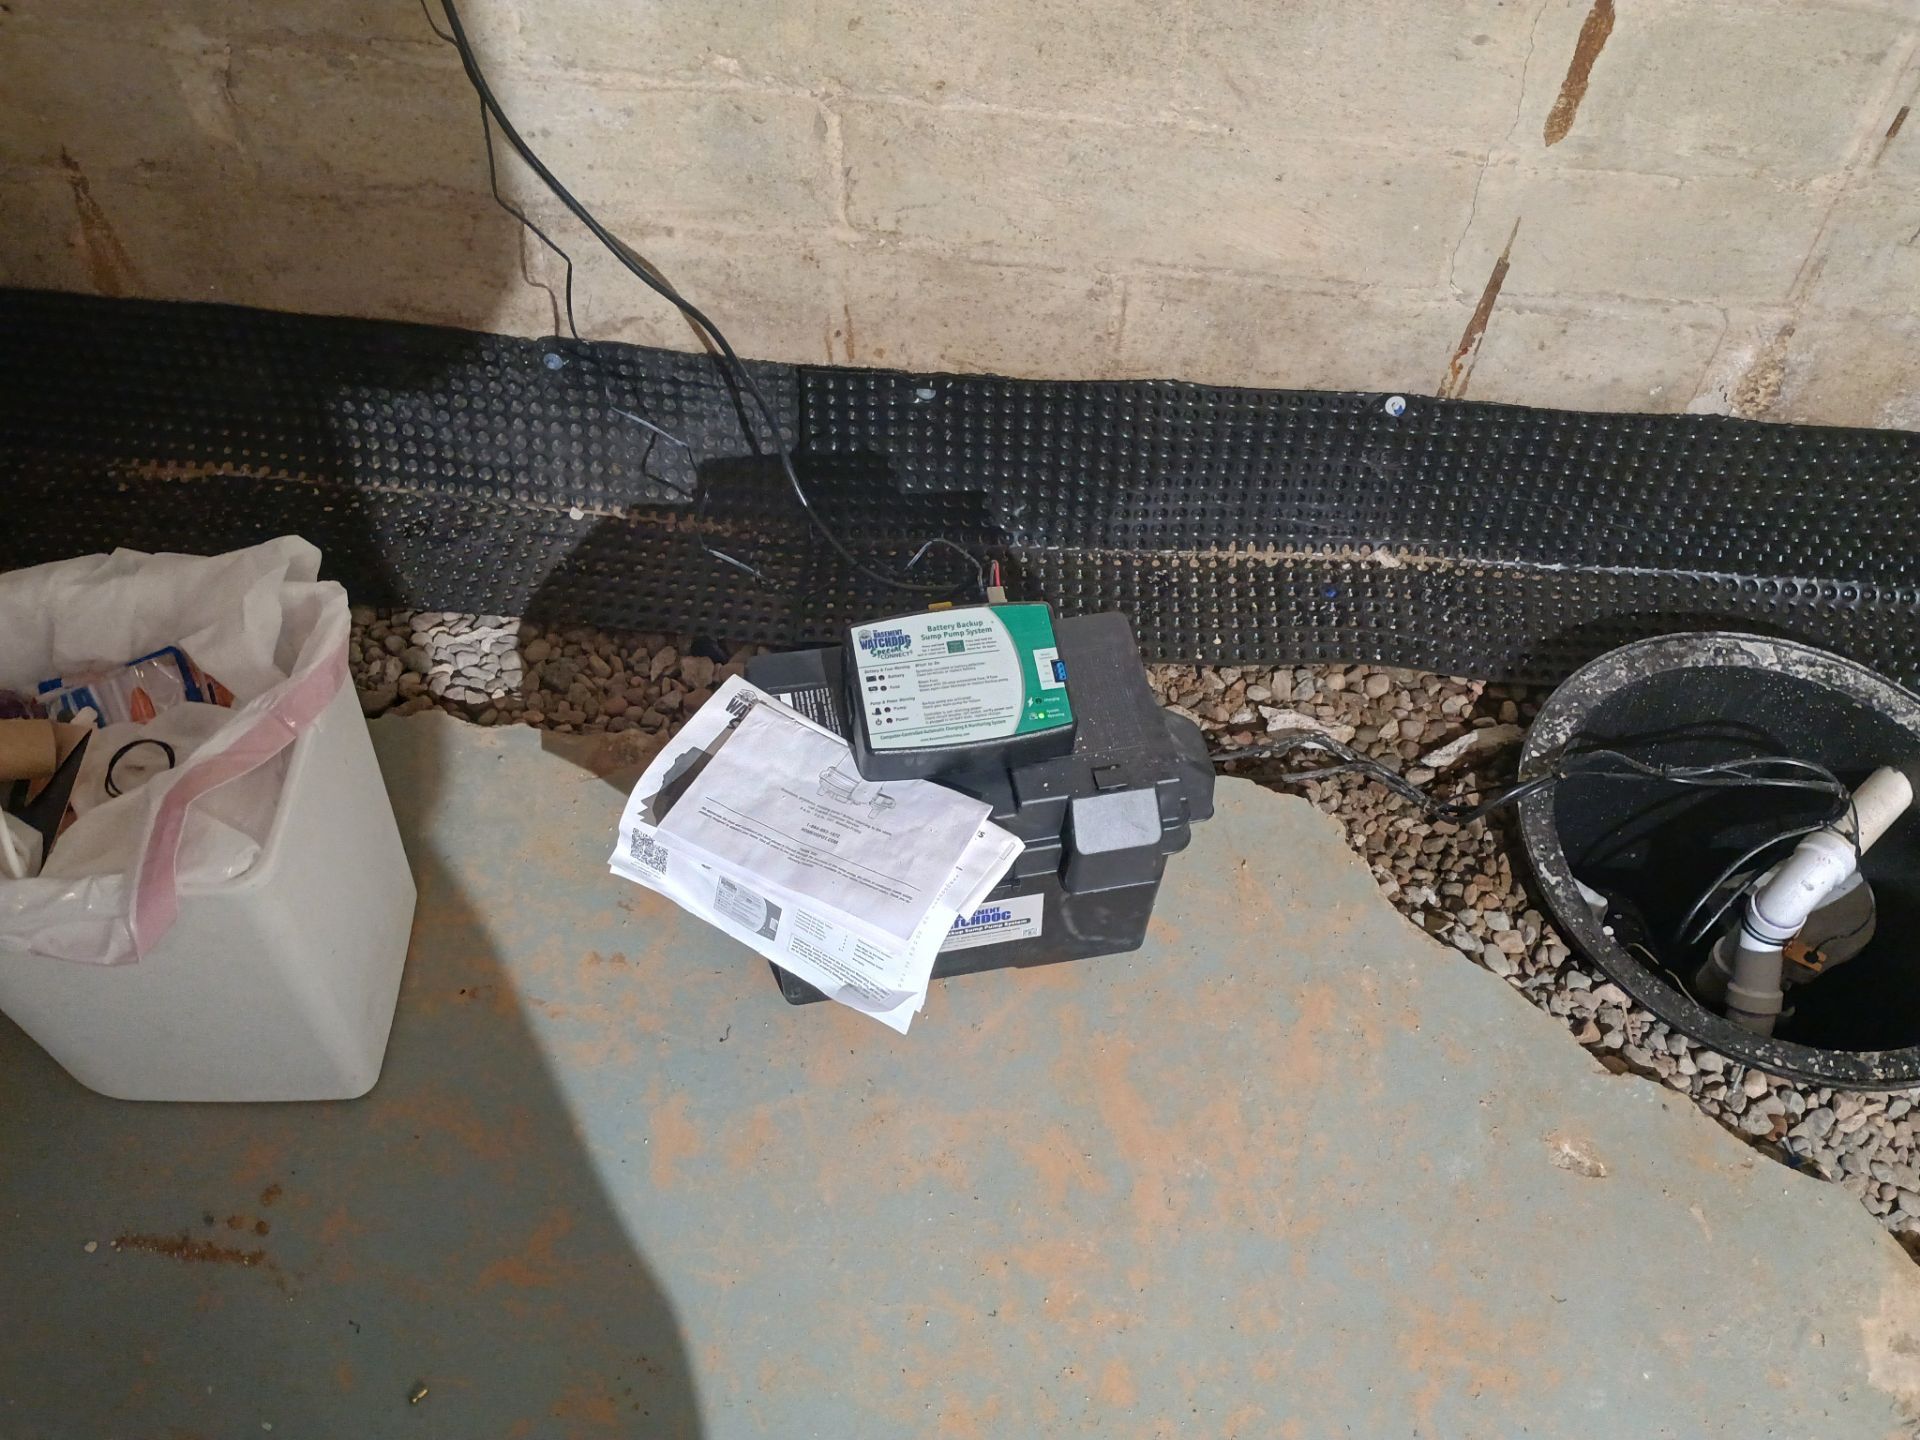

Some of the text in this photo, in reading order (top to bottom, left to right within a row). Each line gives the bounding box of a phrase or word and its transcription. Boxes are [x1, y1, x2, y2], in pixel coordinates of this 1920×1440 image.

[927, 620, 983, 632] Battery Backup
[873, 629, 902, 638] BASEMENT
[965, 627, 992, 636] System
[860, 634, 911, 650] WATCHDOG
[984, 923, 1004, 931] Pump
